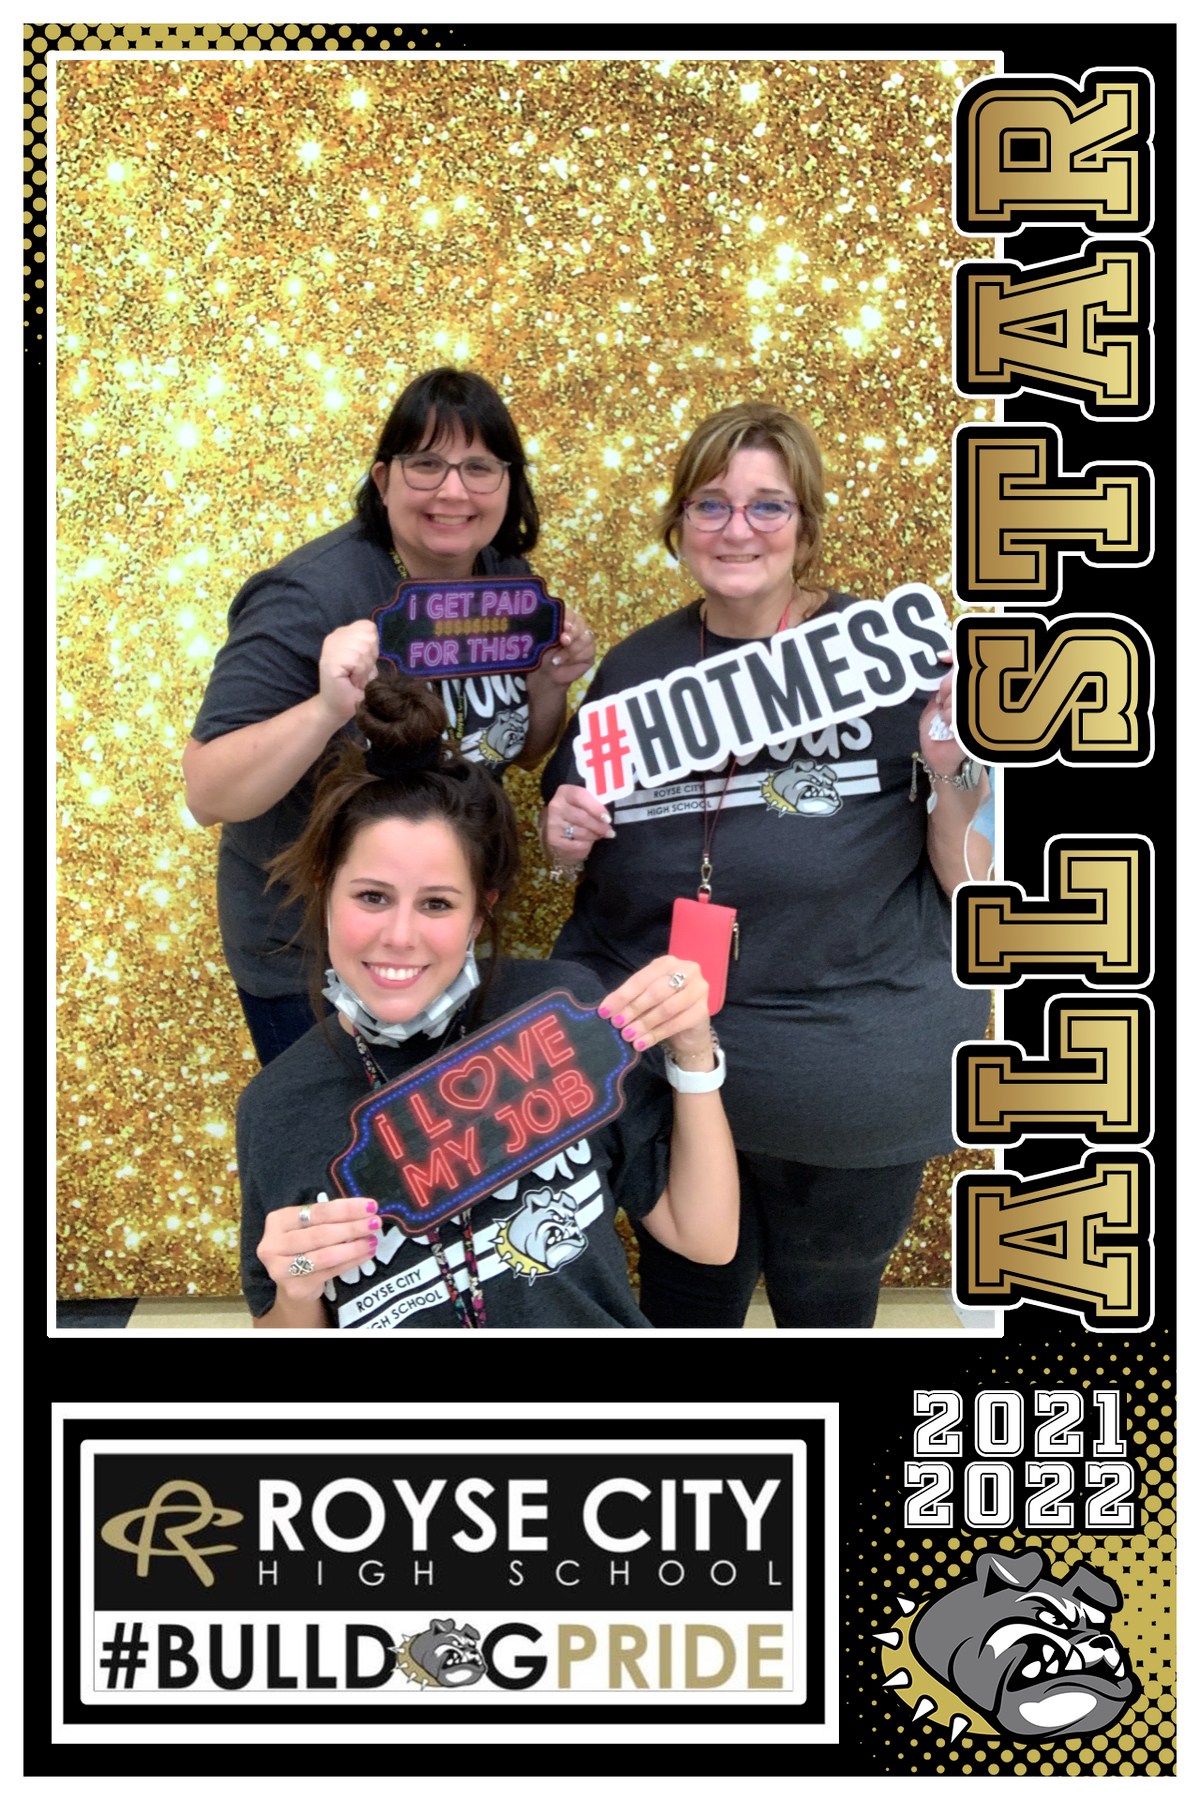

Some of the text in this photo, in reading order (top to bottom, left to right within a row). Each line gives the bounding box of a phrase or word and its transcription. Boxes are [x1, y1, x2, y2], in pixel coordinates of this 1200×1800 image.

[426, 592, 475, 619] GET
[410, 640, 459, 668] FOR
[582, 592, 952, 796] #HOTMESS
[653, 784, 704, 798] ROYSE CITY
[647, 800, 712, 817] HIGH SCHOOL
[402, 1126, 482, 1208] MY
[495, 1069, 594, 1153] JOB
[356, 1269, 422, 1313] ROYSE CITY
[391, 1289, 443, 1320] SCHOOL
